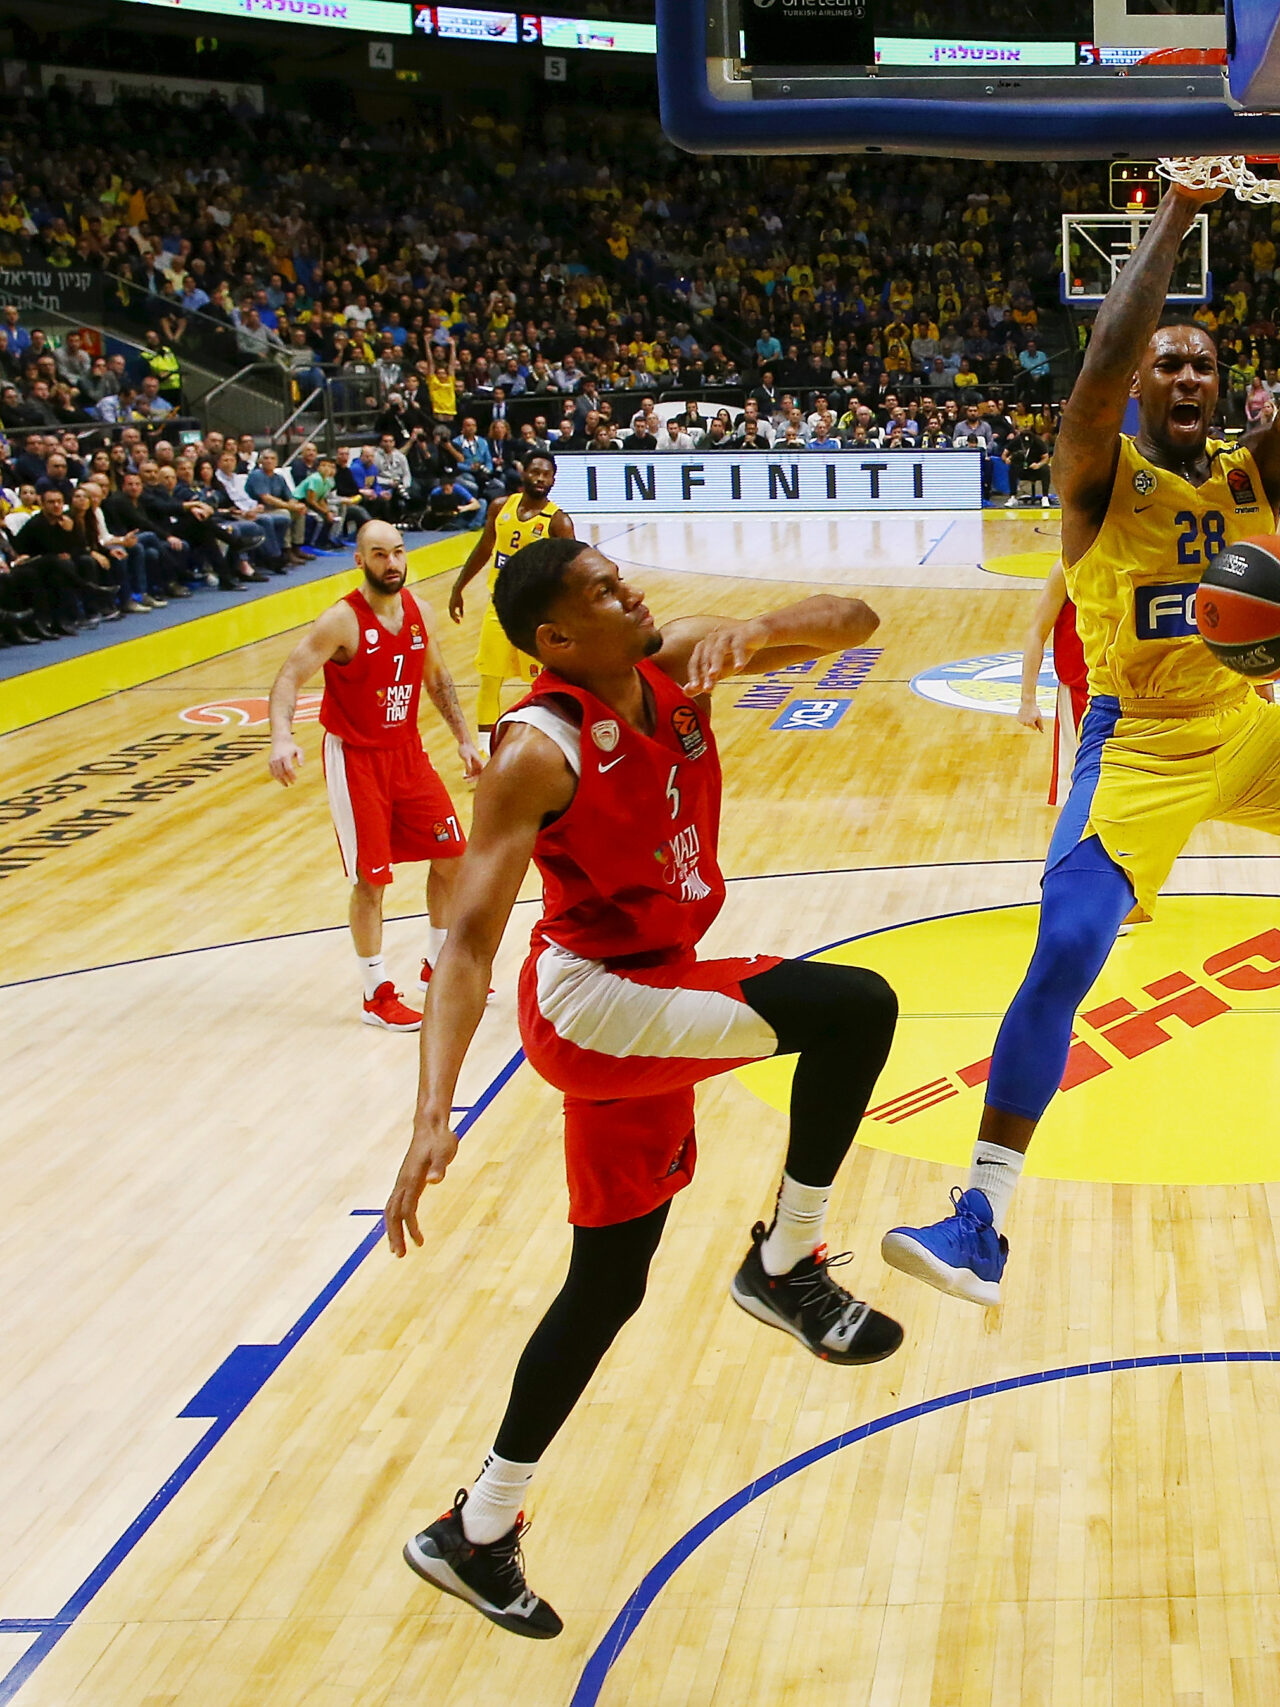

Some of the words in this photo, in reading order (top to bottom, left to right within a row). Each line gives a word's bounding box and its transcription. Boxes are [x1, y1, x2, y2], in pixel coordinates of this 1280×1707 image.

[240, 0, 347, 19] אופטלגן.
[414, 8, 434, 34] 4
[521, 17, 539, 42] 5
[550, 61, 561, 77] 5
[586, 463, 923, 501] INFINITI
[510, 530, 521, 549] 2
[1174, 510, 1226, 564] 28
[393, 654, 404, 682] 7
[814, 648, 885, 690] MACCABI
[782, 701, 839, 729] FOX
[446, 815, 461, 843] 7
